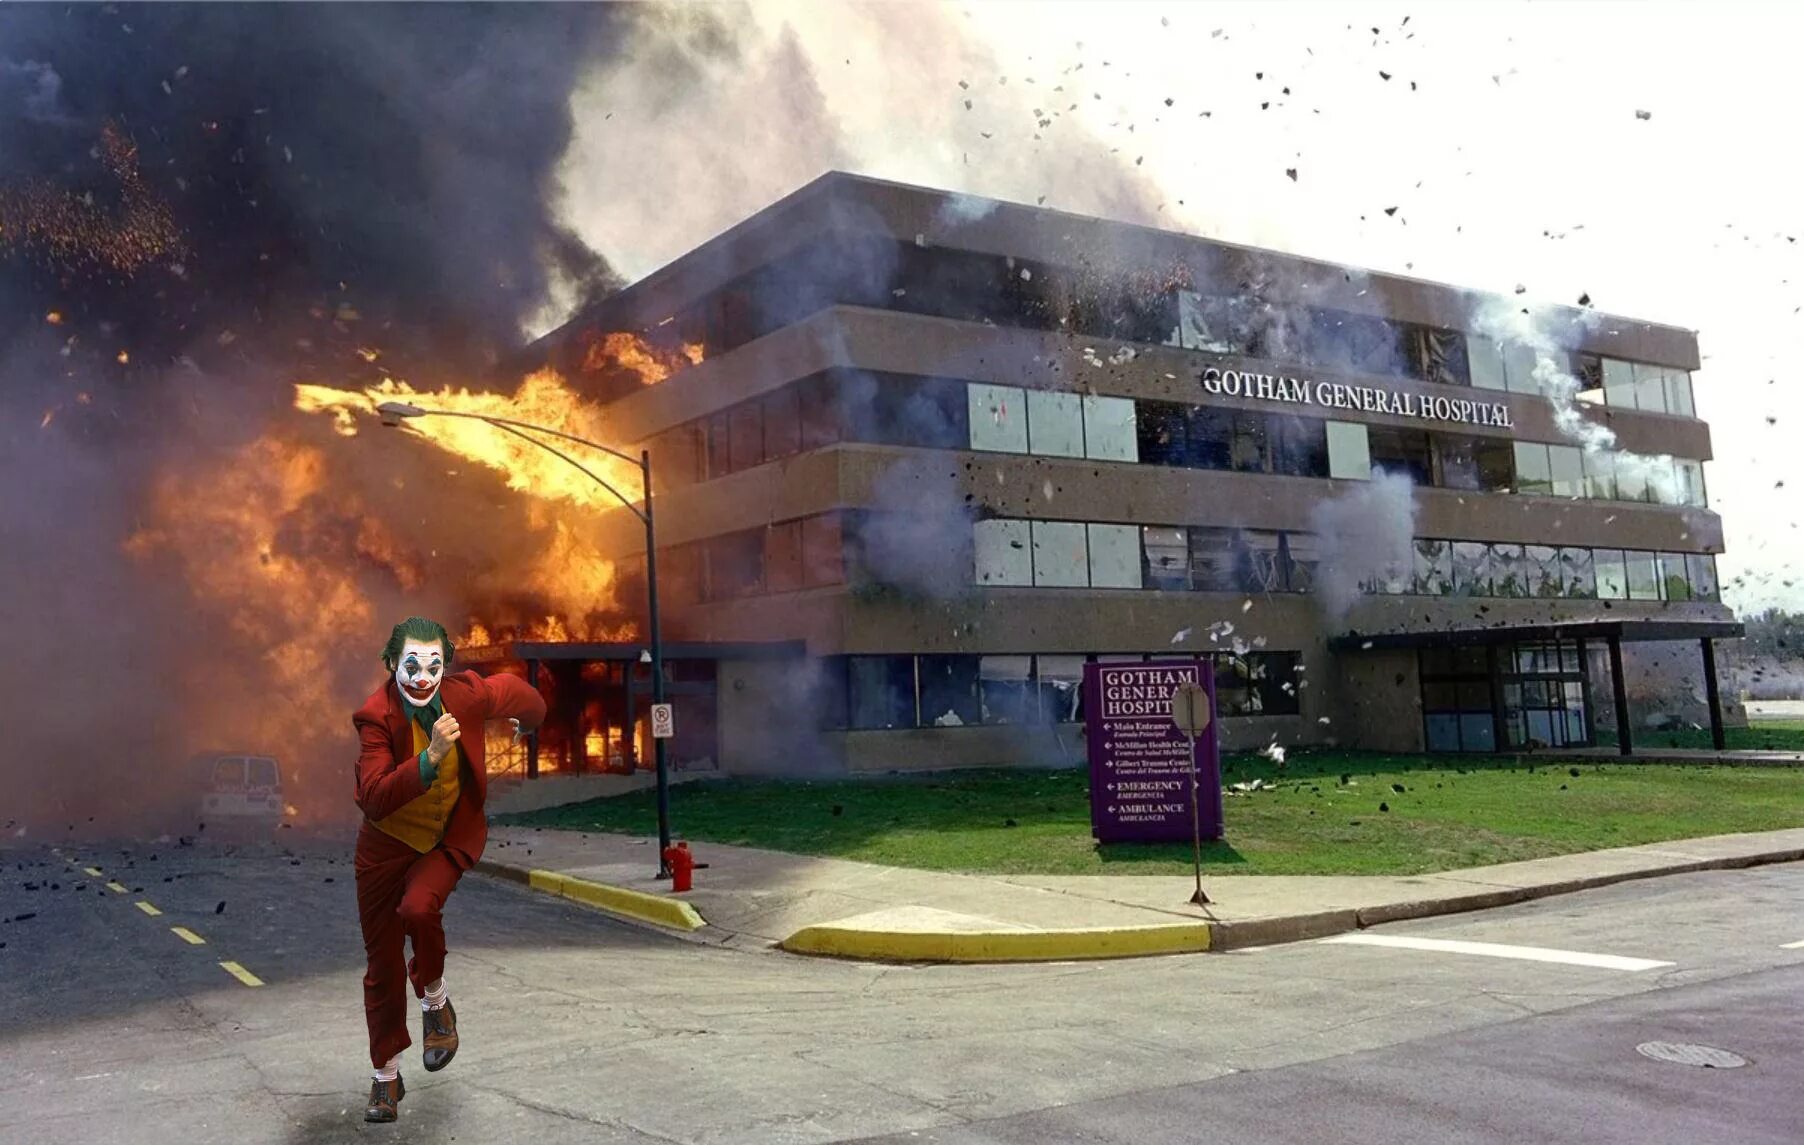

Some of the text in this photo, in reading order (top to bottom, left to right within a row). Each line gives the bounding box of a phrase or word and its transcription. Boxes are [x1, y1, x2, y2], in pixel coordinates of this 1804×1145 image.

[1203, 368, 1514, 428] GOTHAM GENERAL HOSPITAL
[1106, 671, 1192, 685] GOTHAM
[1107, 686, 1179, 699] GENERA
[1108, 700, 1172, 714] HOSPIT
[1117, 781, 1182, 791] EMERGENCY
[1119, 804, 1184, 813] AMBULANCE
